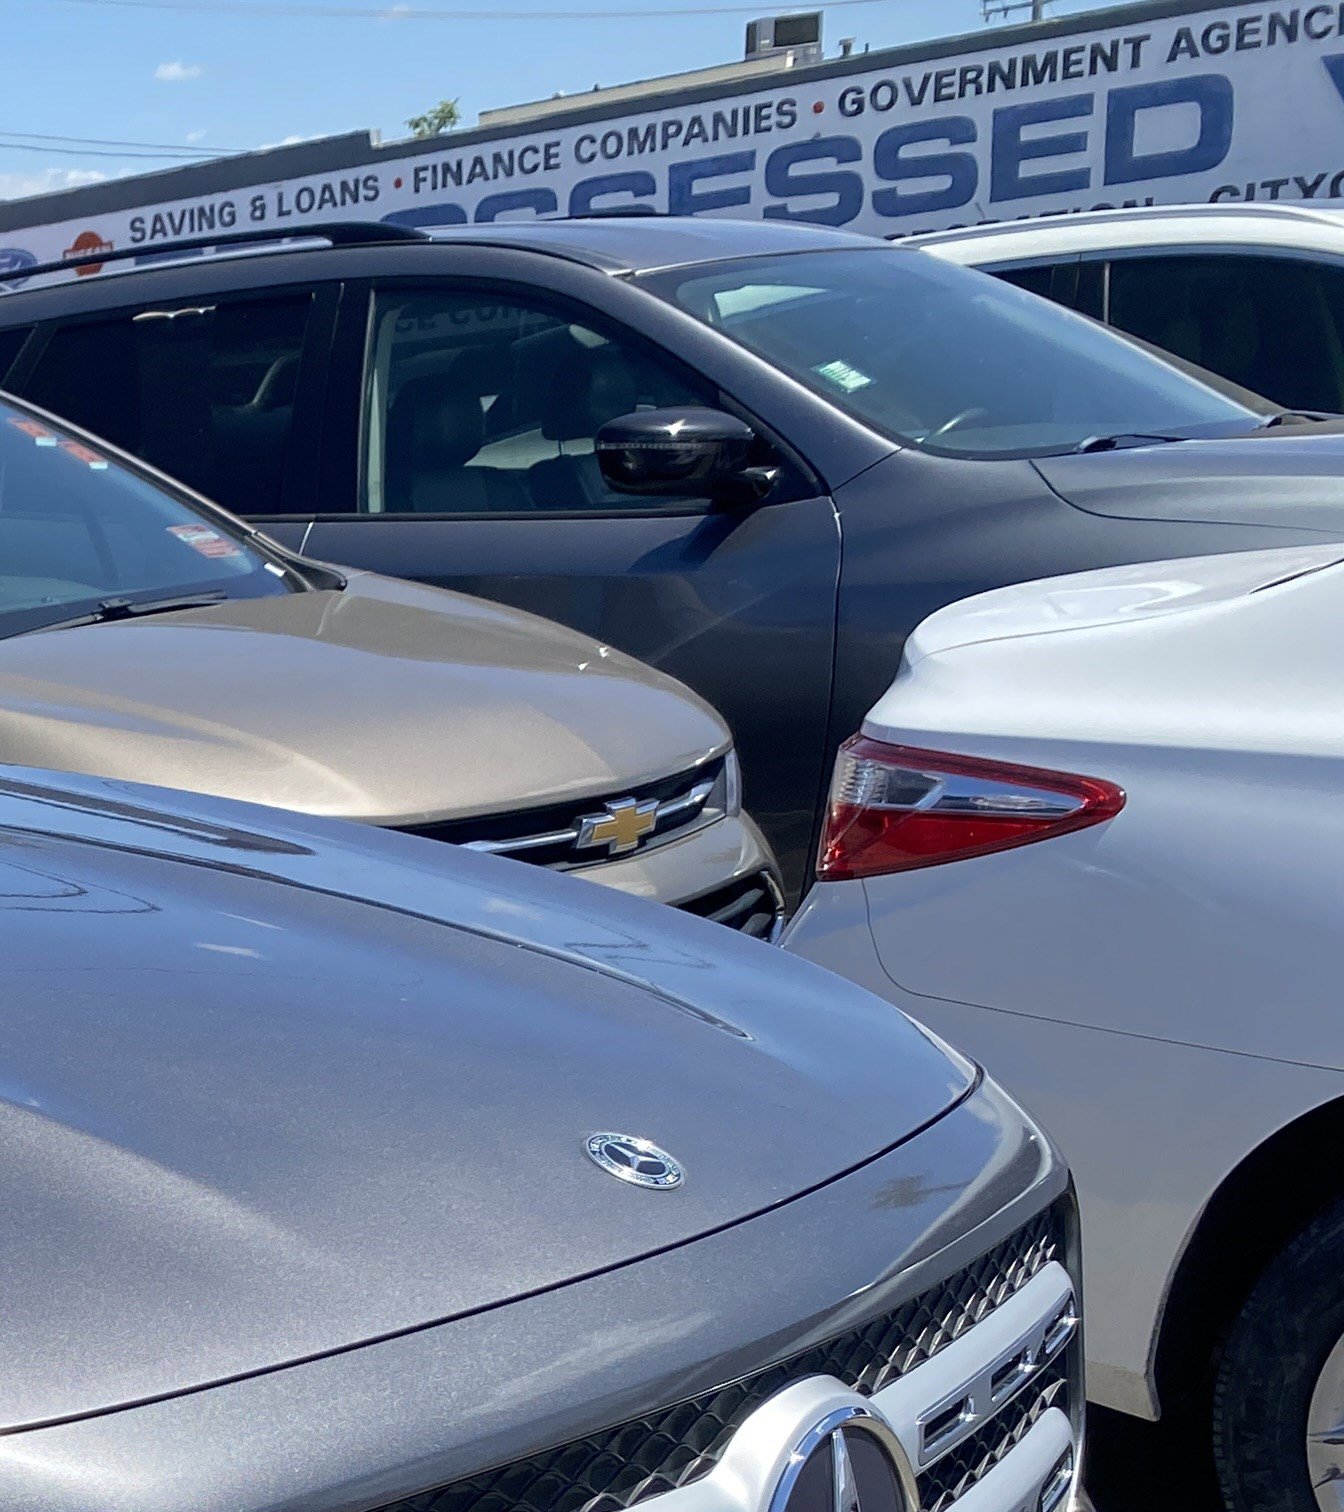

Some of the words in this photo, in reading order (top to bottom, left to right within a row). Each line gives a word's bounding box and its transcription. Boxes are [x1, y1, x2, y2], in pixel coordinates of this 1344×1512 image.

[129, 200, 236, 243] SAVING
[248, 195, 267, 222] &
[277, 175, 380, 218] LOANS
[413, 141, 562, 194] FINANCE
[573, 97, 798, 165] COMPANIES
[838, 33, 1152, 118] GOVERNMENT
